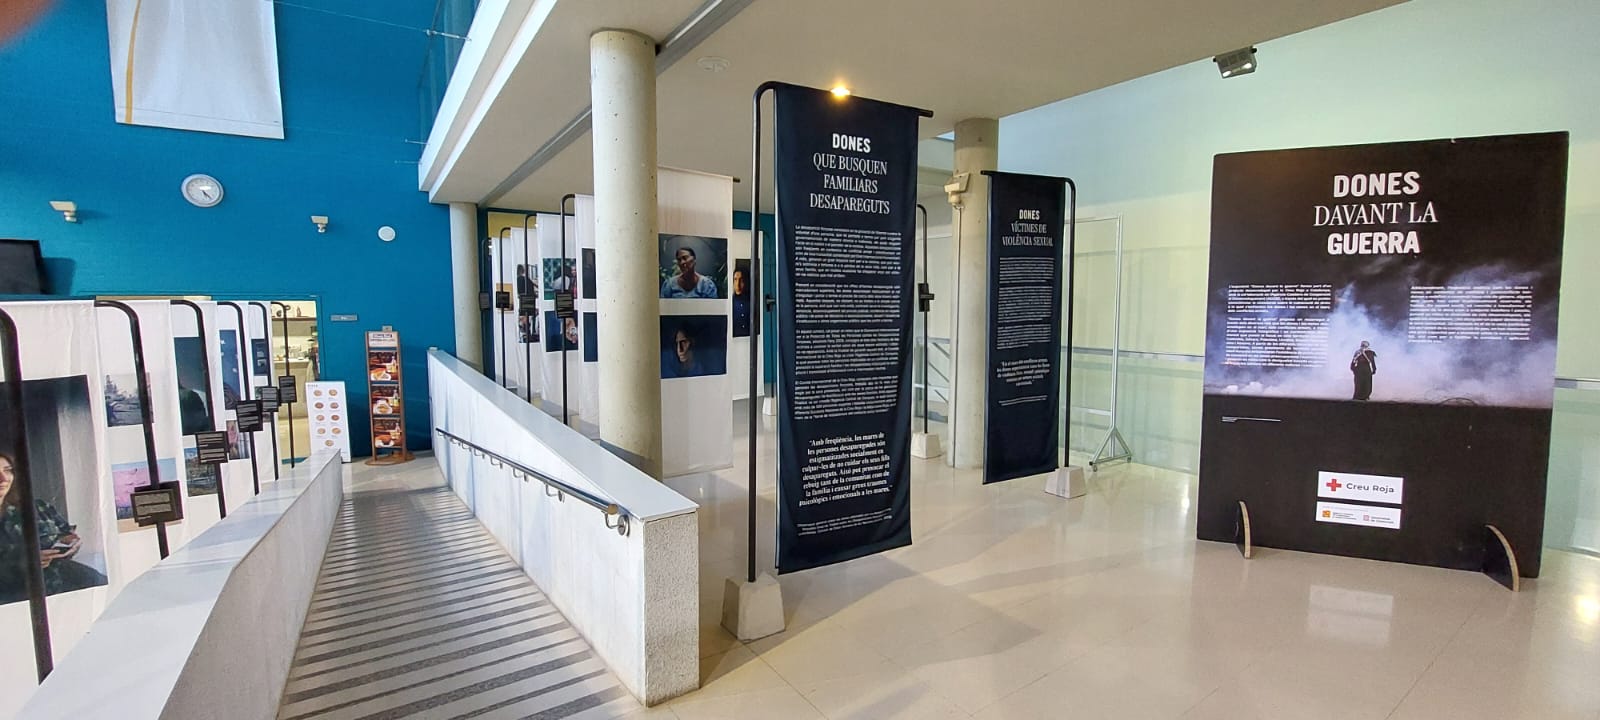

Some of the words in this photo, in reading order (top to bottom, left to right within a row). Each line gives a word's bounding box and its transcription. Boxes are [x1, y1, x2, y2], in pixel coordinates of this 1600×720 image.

[832, 133, 871, 153] DONES
[813, 153, 837, 171] QUE
[838, 155, 888, 176] BUSQUEN
[823, 174, 878, 194] FAMILIARS
[1333, 171, 1421, 198] DONES
[810, 193, 890, 215] DESAPAREGUTS
[1313, 202, 1403, 227] DAVANT
[1408, 201, 1438, 224] LA
[1019, 209, 1041, 220] DONES
[1011, 221, 1039, 233] VÍCTIMES
[1039, 224, 1047, 233] DE
[1033, 236, 1053, 247] SEXUAL
[1327, 231, 1421, 255] GUERRA
[1346, 483, 1370, 491] Creu
[1372, 484, 1395, 494] Roja
